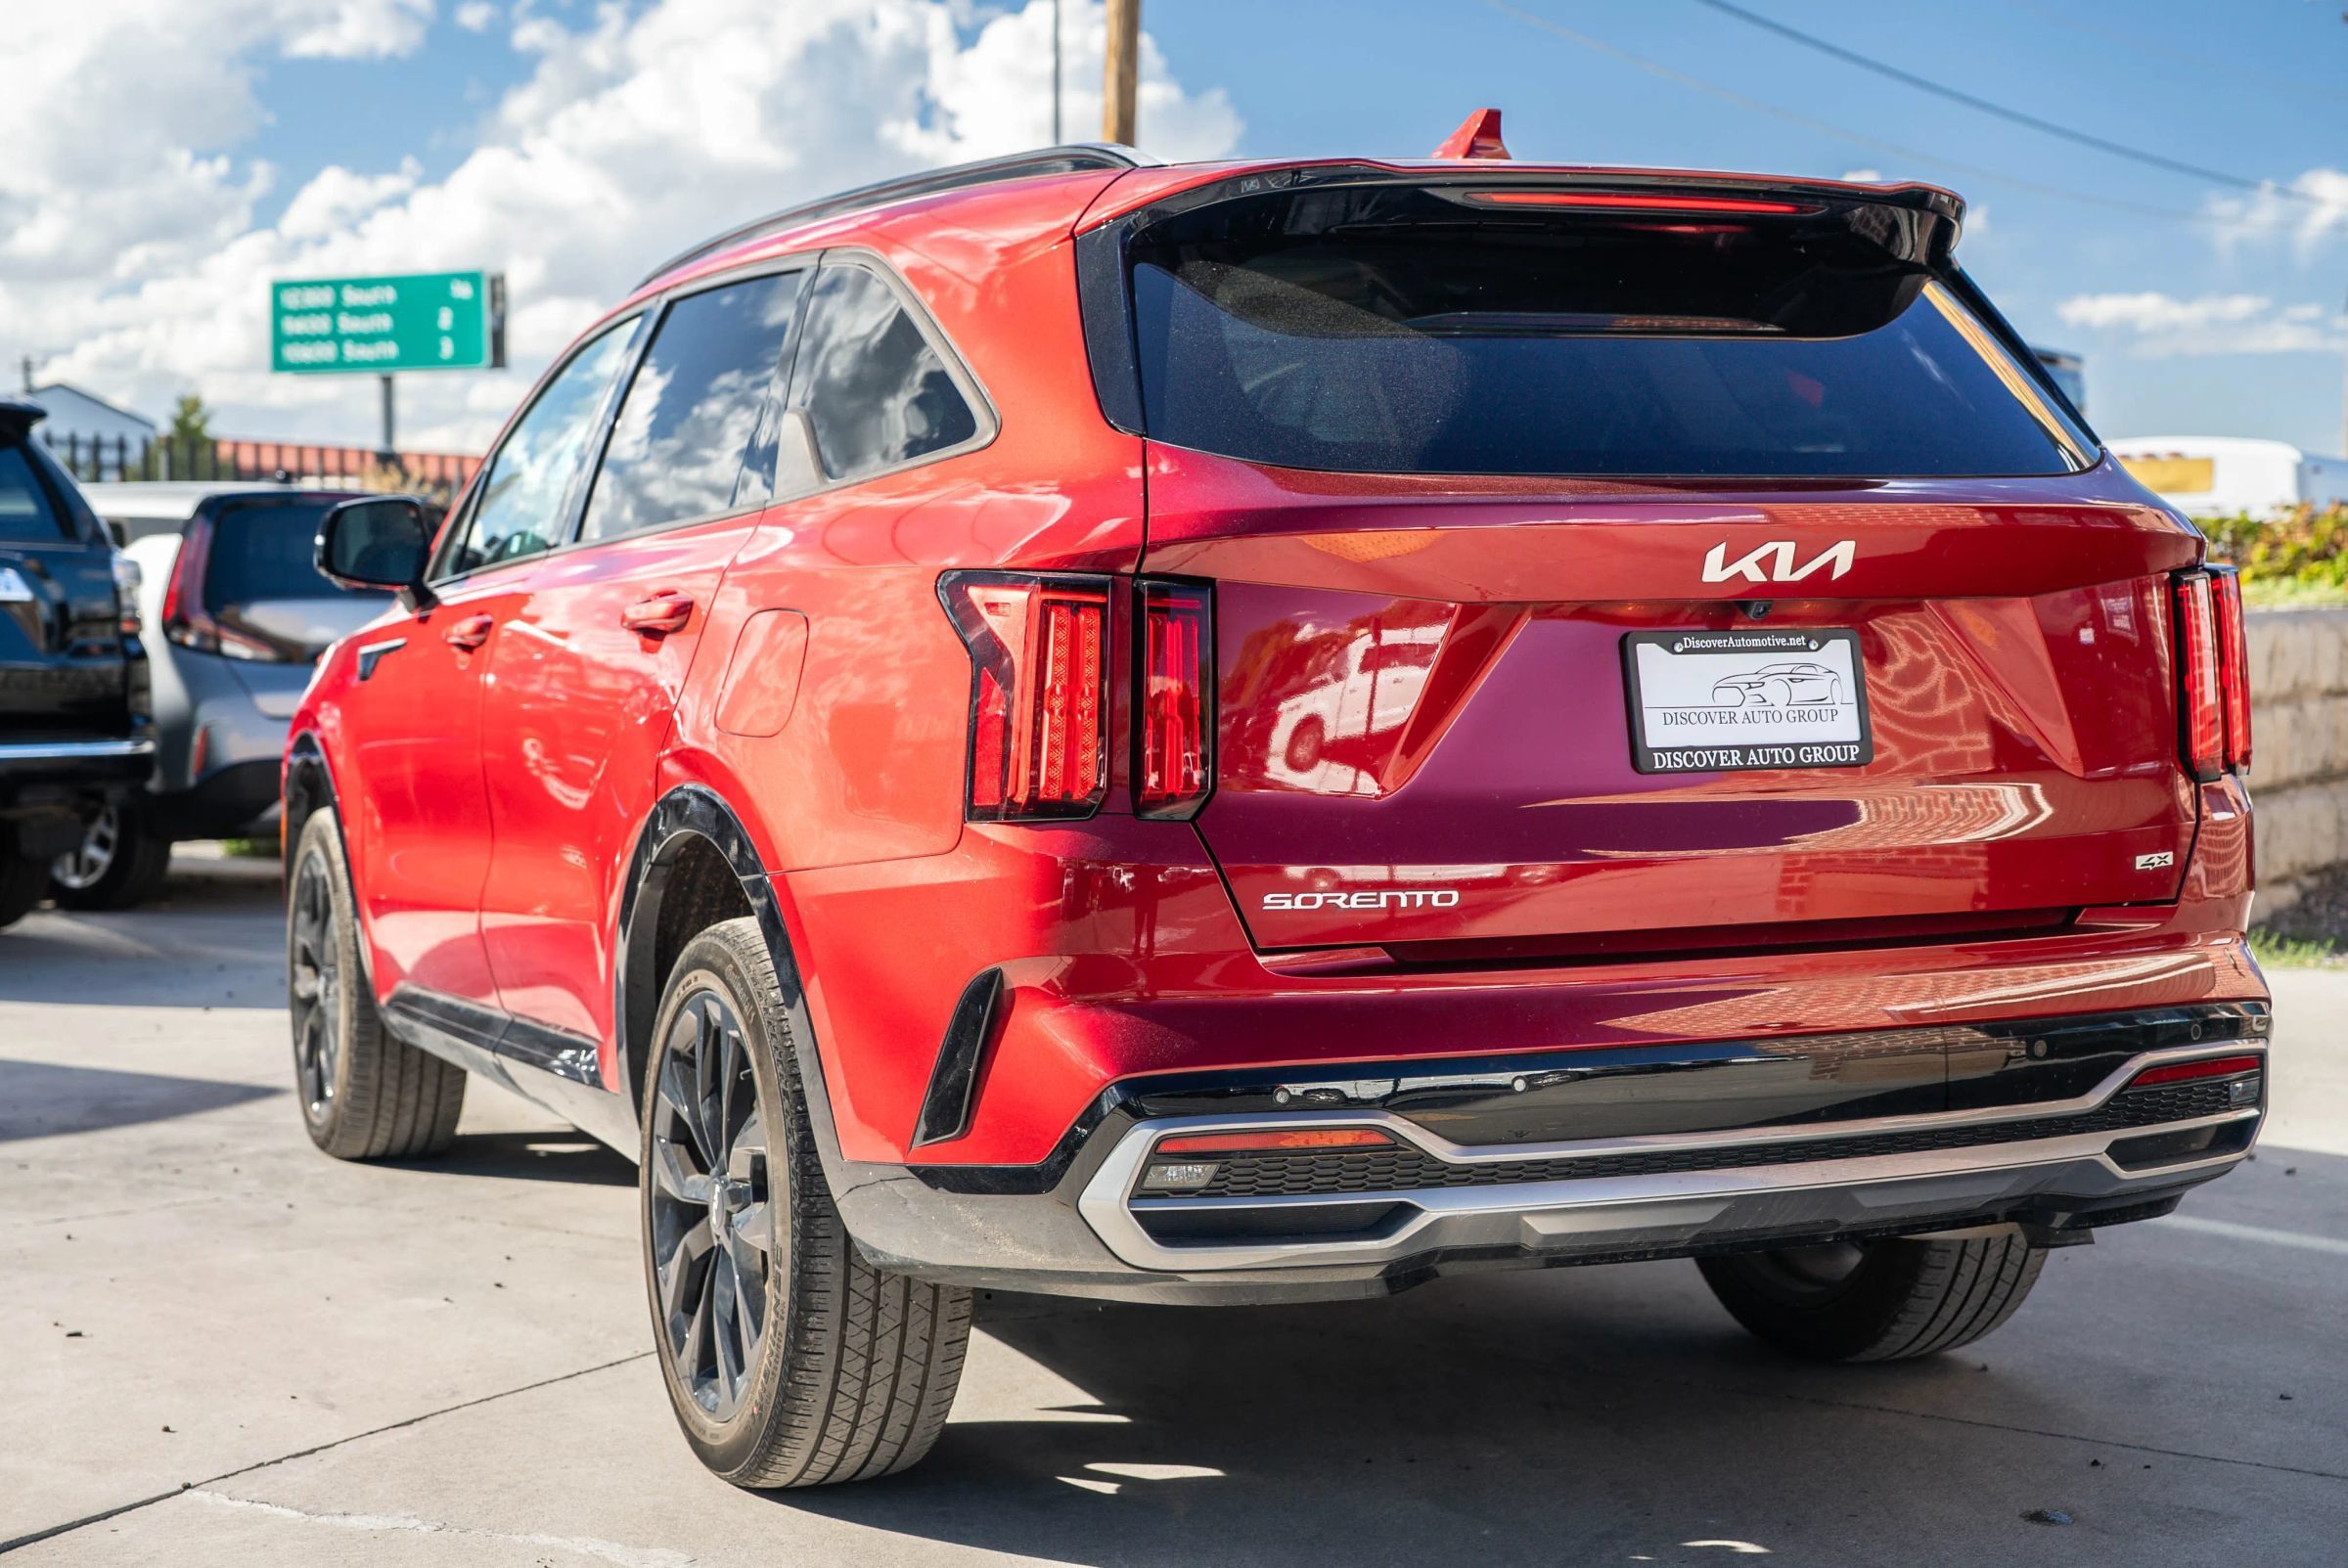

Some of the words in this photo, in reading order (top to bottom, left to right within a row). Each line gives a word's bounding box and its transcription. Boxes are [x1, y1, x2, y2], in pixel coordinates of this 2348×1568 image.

[1700, 540, 1857, 583] KIA
[1683, 635, 1806, 649] DiscoverAutomotive.net
[1663, 710, 1738, 726] DISCOVER
[1741, 709, 1783, 724] AUTO
[1785, 708, 1838, 723] GROUP
[1653, 749, 1743, 769] DISCOVER
[1746, 746, 1795, 766] AUTO
[1799, 744, 1860, 763] GROUP
[1262, 890, 1460, 910] SORENTO
